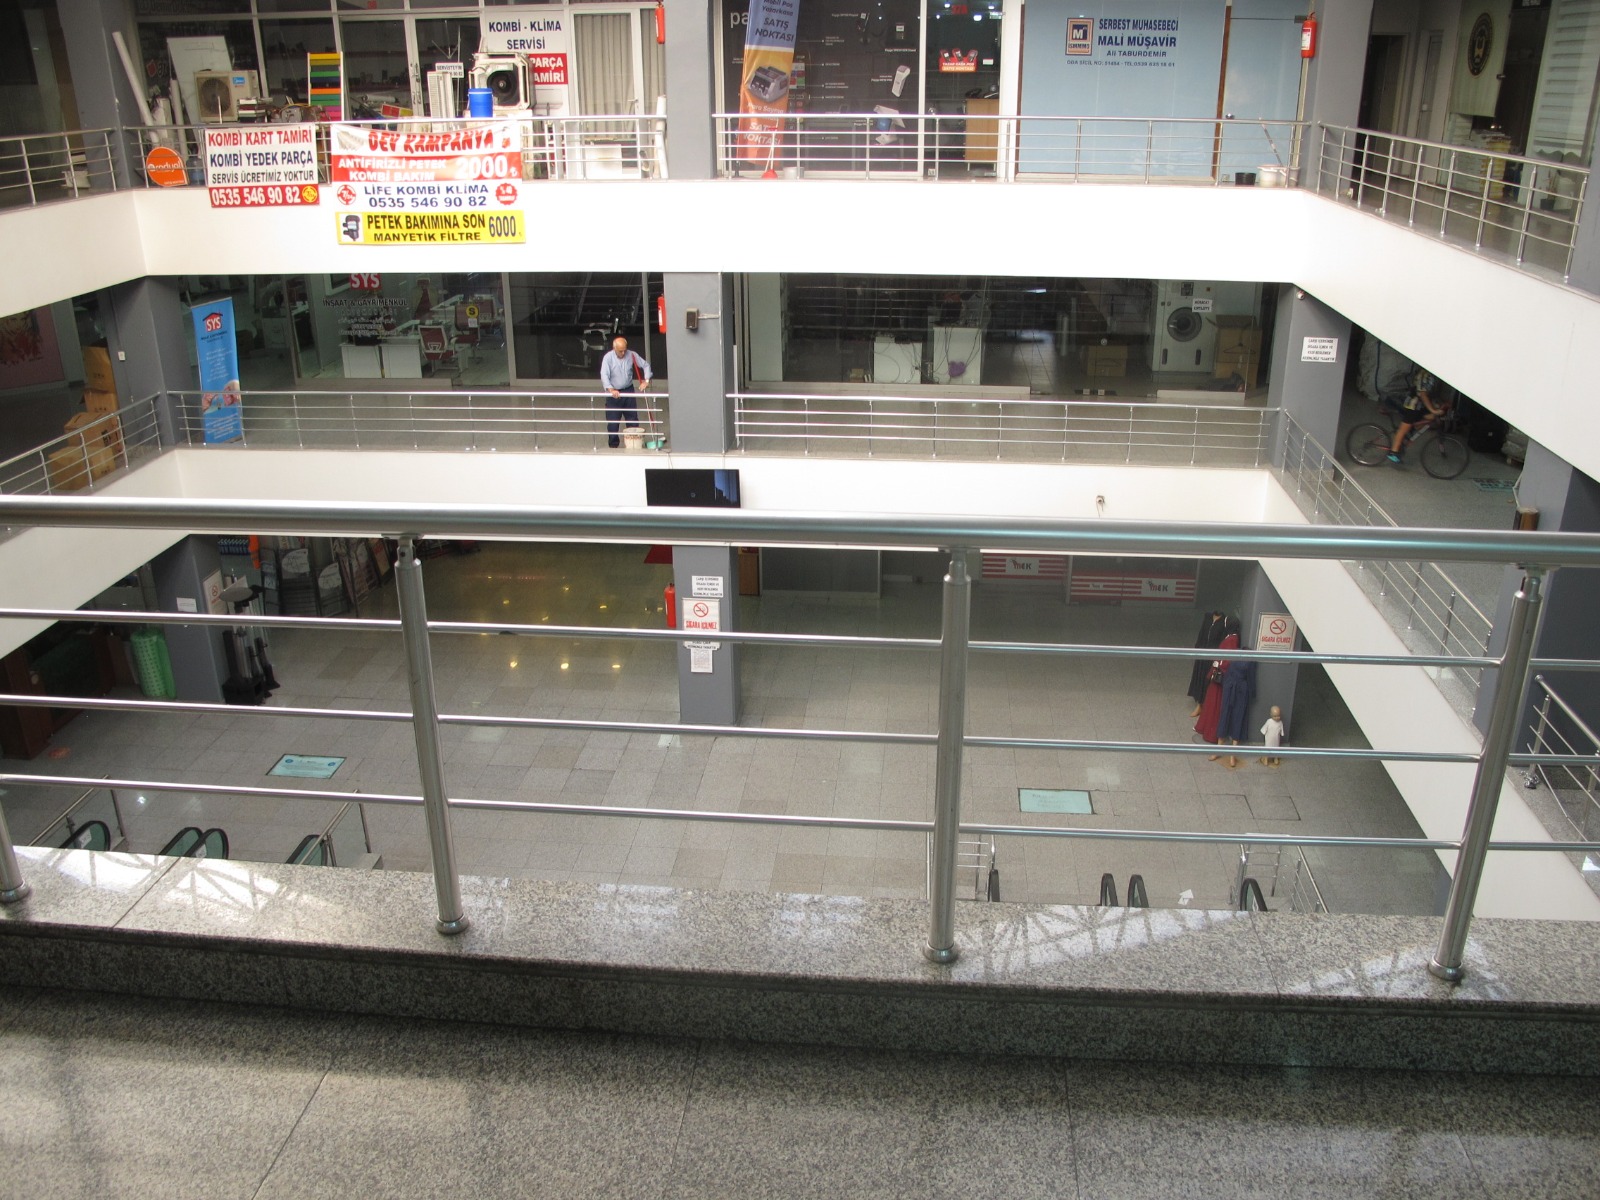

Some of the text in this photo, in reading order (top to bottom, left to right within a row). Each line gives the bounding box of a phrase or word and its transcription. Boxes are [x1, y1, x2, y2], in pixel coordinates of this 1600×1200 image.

[489, 19, 521, 32] KOMBİ
[530, 19, 561, 32] KLİMA
[764, 17, 789, 30] SATIŞ
[1099, 17, 1179, 31] SERBEST MUHASEBECİ
[755, 28, 794, 42] NOKTASI
[1098, 33, 1176, 49] MALİ MÜŞAVİR
[507, 37, 545, 50] SERVİSİ
[534, 71, 564, 82] AMİRİ
[208, 126, 312, 146] KOMBİ KART TAMİRİ
[368, 129, 493, 153] DEV KAMPANYA
[210, 150, 314, 168] KOMBİ YEDEK PARÇA
[338, 158, 447, 169] ANTİFİRİZLİ PETEK
[212, 170, 314, 184] SERVİS ÜCRETİMİZ YOKTUR
[349, 170, 435, 181] KOMBİ BAKIM
[212, 188, 241, 206] 0535
[244, 187, 265, 204] 546
[267, 187, 283, 204] 90
[285, 186, 301, 203] 82
[364, 183, 489, 195] LİFE KOMBİ KLİMA
[369, 196, 487, 208] 0535 546 90 82
[367, 214, 485, 230] PETEK BAKIMINA SON
[489, 216, 516, 238] 6000
[374, 231, 481, 242] MANYETİK FİLTRE
[351, 273, 380, 288] SYS
[323, 298, 347, 308] İNŞAAT
[206, 317, 221, 331] SYS
